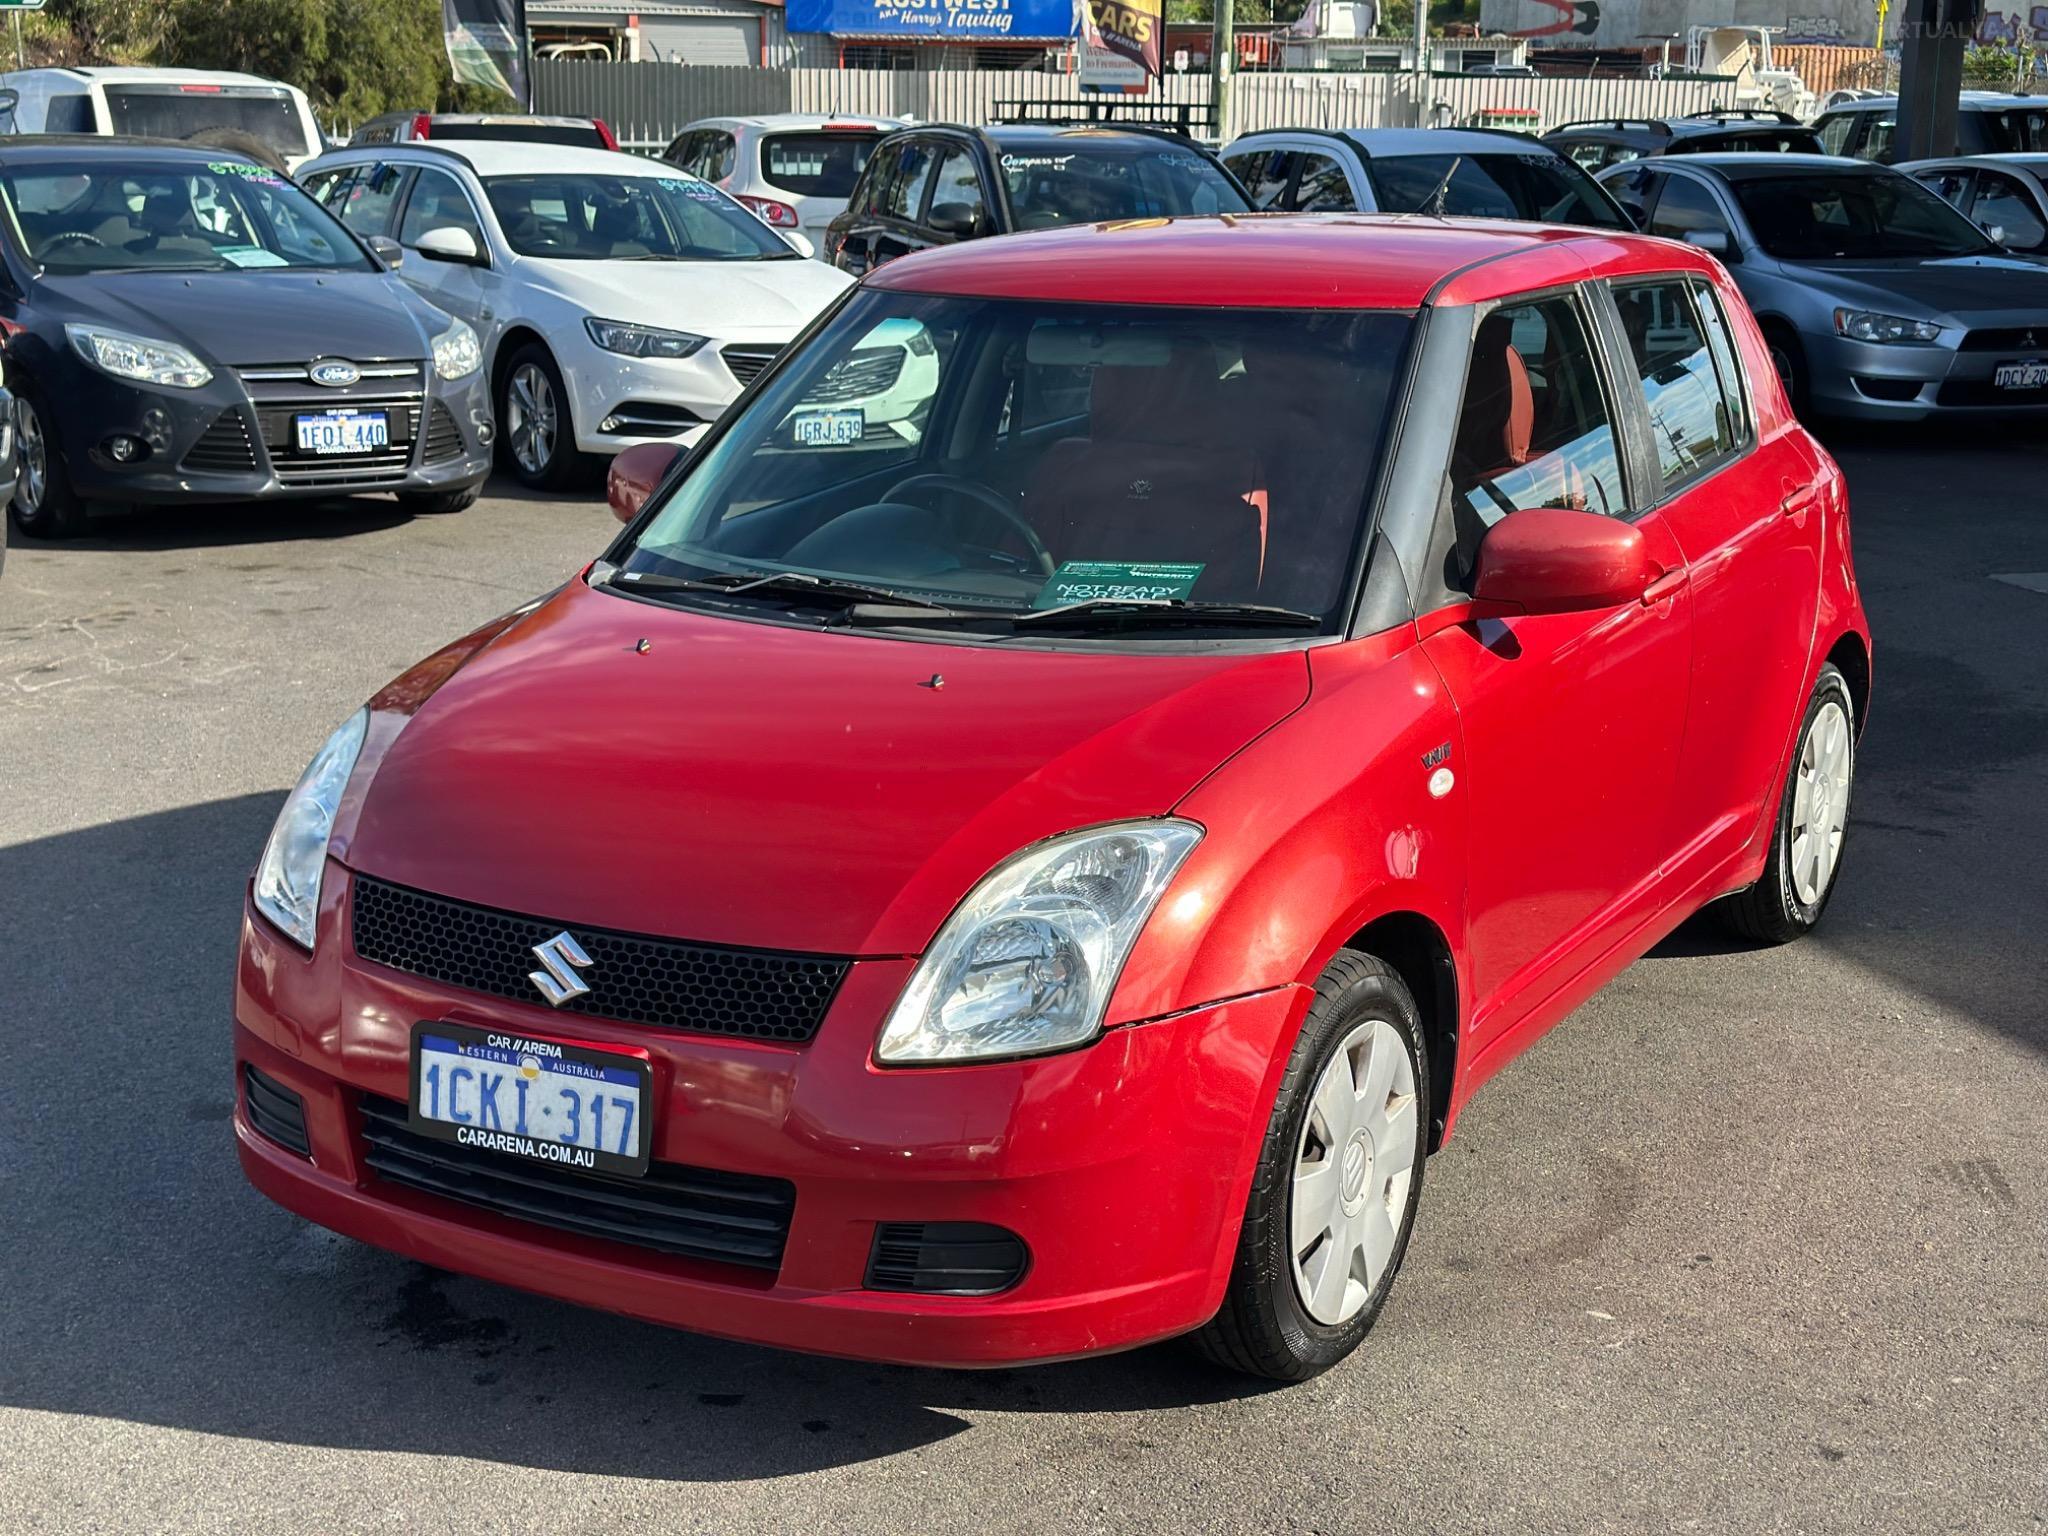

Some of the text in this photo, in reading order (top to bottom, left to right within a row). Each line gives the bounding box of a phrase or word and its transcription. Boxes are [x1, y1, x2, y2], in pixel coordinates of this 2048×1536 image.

[879, 7, 1013, 33] AKA Harry's Towing
[1087, 0, 1153, 43] CARS
[2031, 368, 2048, 384] 20
[355, 424, 385, 446] 440
[798, 420, 861, 441] 1GRJ 639
[1056, 584, 1180, 594] NOT READY
[1063, 590, 1108, 598] FOR
[487, 1034, 511, 1050] CAR
[458, 1045, 605, 1080] WESTERN AUSTRALIA
[457, 1127, 595, 1168] CARARENA.COM.AU
